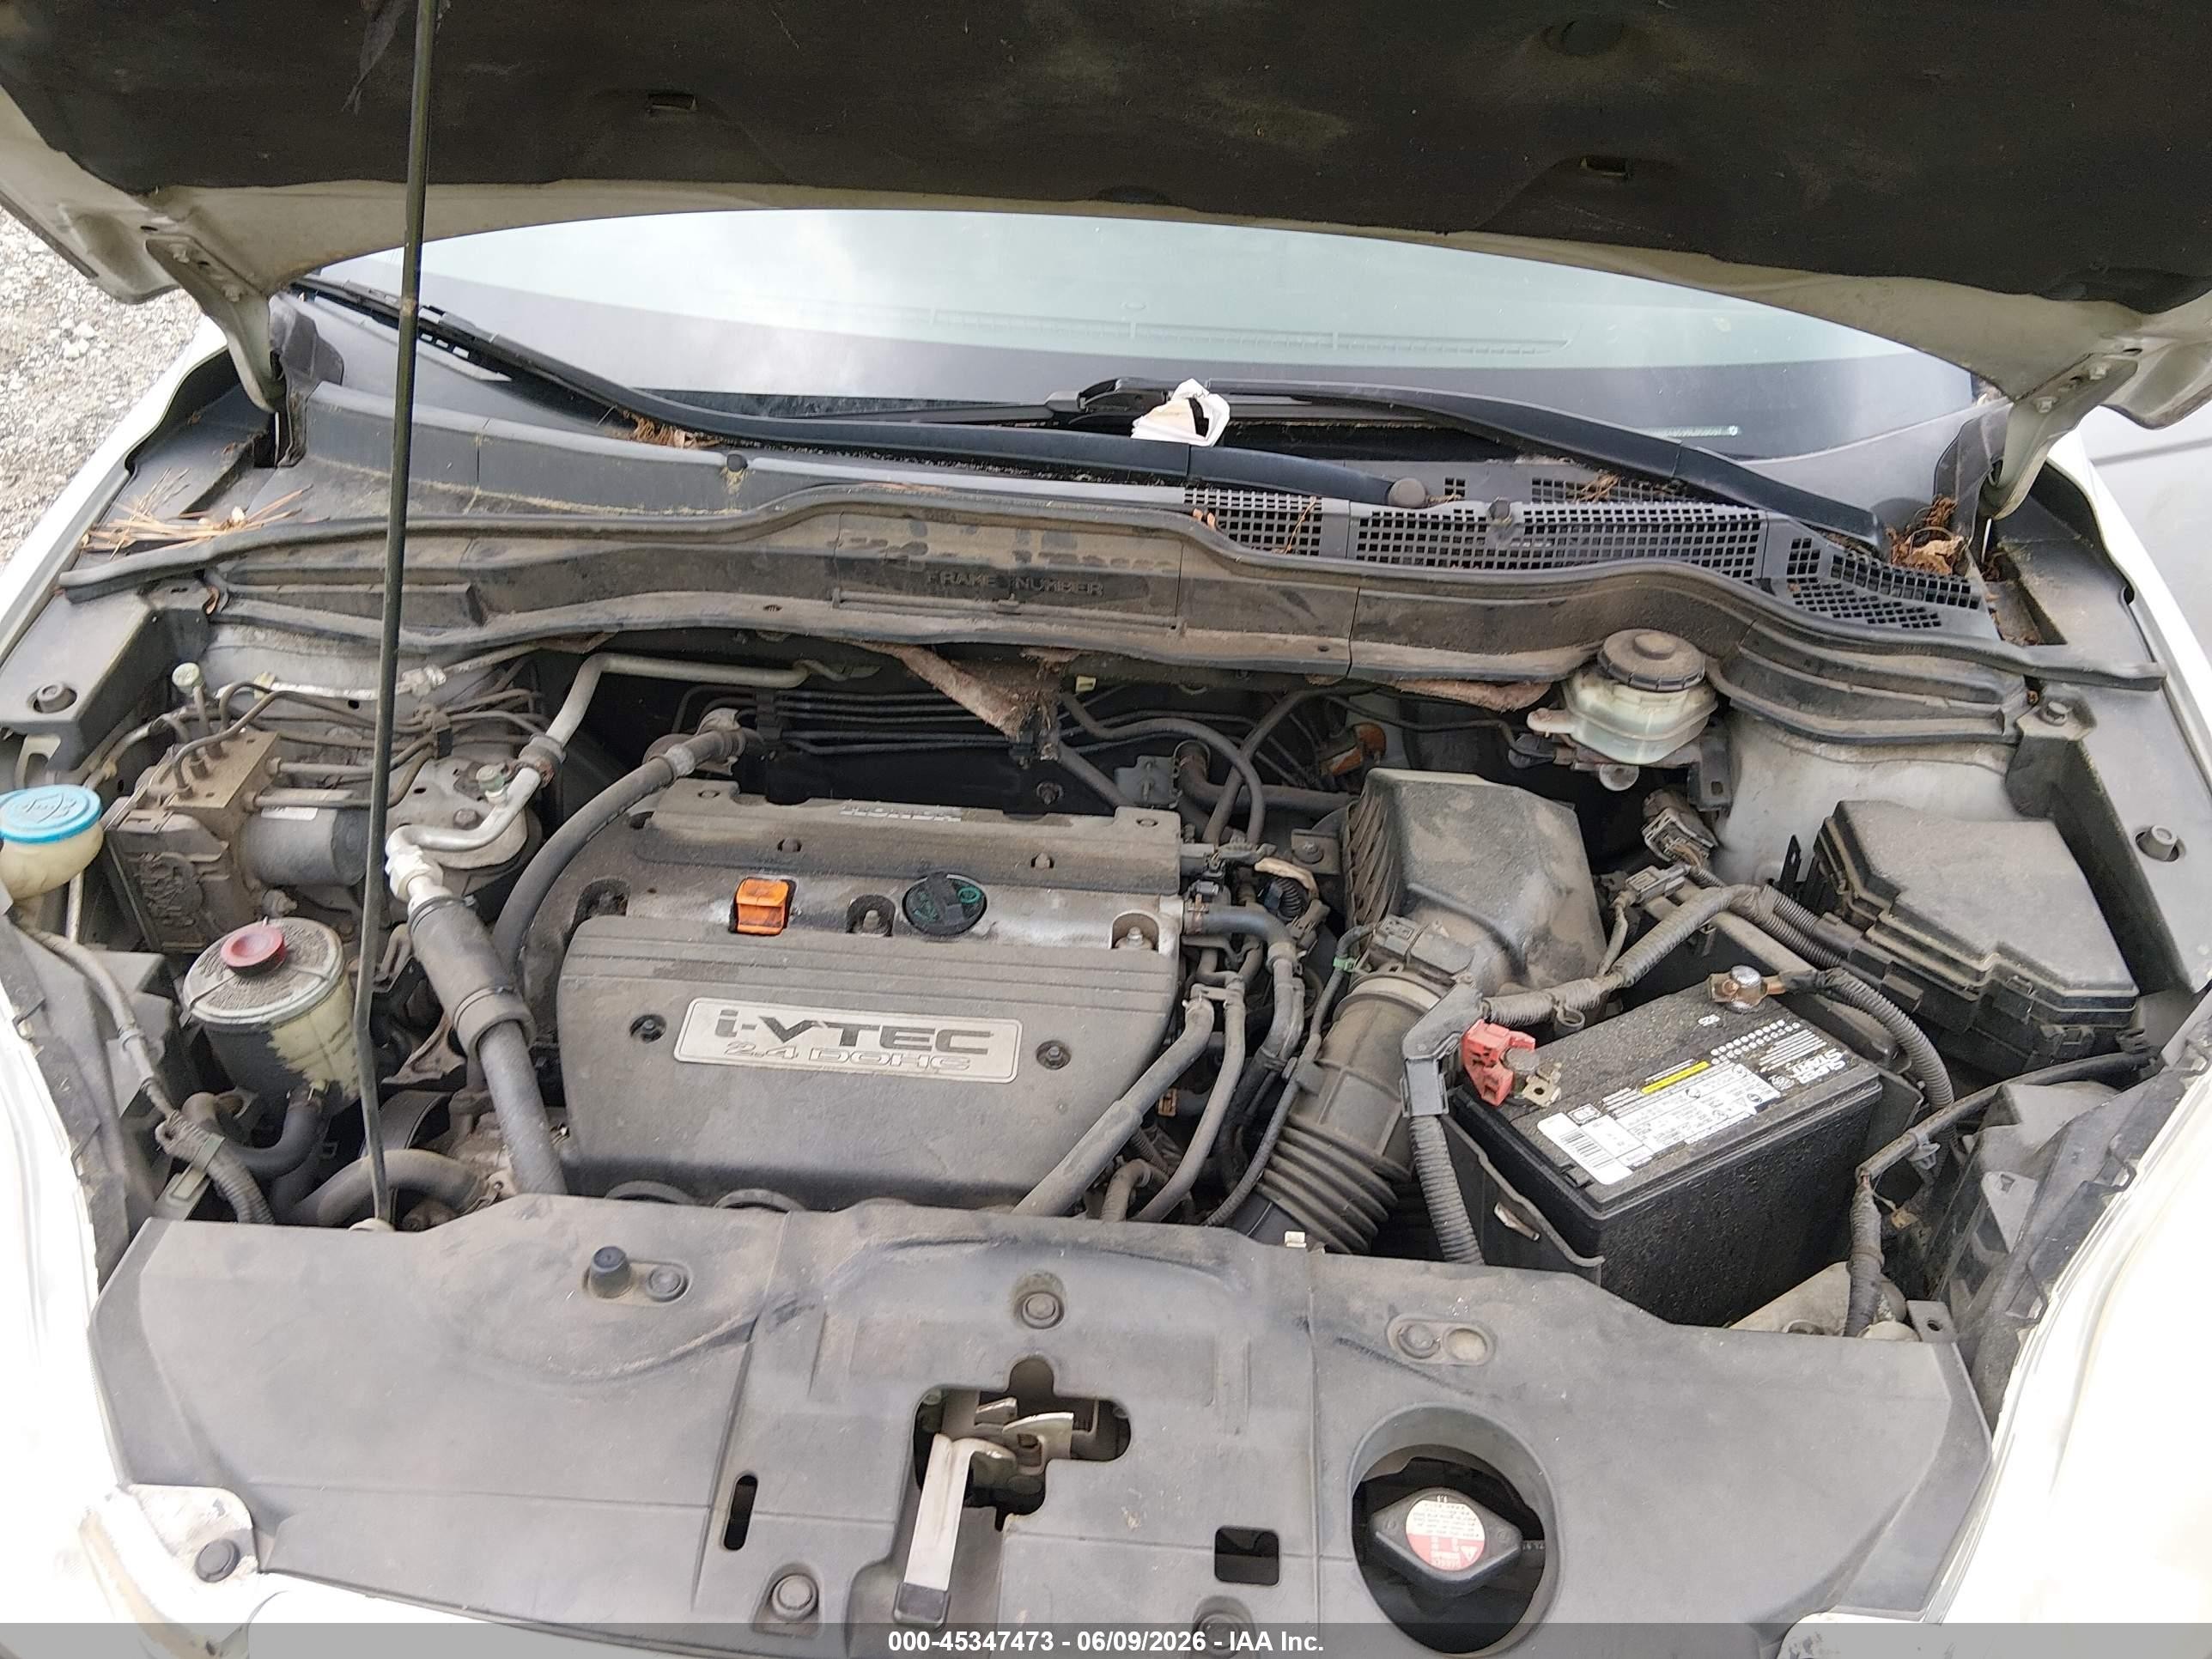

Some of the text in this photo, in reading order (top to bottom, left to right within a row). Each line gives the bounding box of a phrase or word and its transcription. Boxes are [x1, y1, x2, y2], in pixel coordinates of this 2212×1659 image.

[928, 571, 1104, 596] FRAME NUMBER
[714, 1009, 994, 1055] i-VTEC
[723, 1041, 972, 1072] 2.4 DOHC
